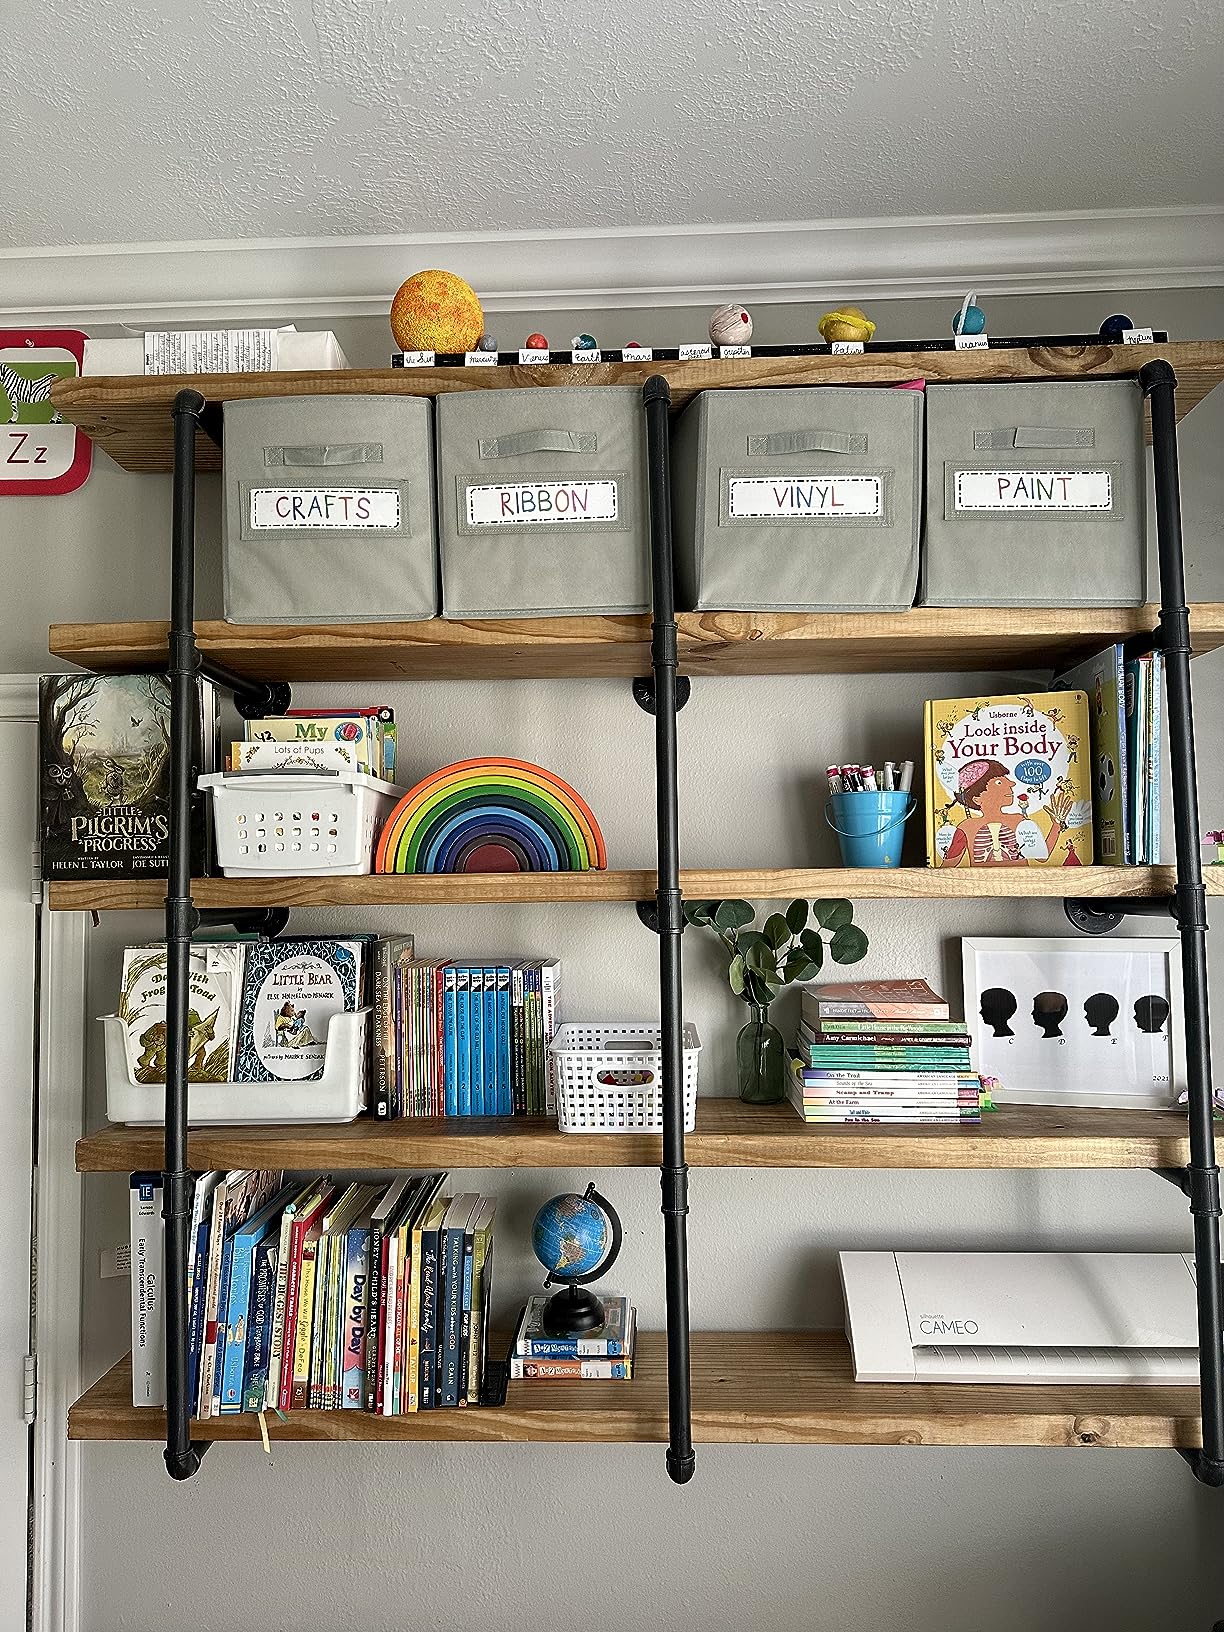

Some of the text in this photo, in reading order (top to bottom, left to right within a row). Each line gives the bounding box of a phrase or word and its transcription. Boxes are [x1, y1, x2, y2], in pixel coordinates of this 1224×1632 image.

[417, 351, 435, 364] Sun
[521, 353, 549, 362] Venus
[575, 353, 600, 363] Earth
[773, 485, 845, 508] VINYL
[997, 477, 1072, 501] PAINT
[275, 495, 372, 520] CRAFTS
[500, 489, 589, 518] RIBBON
[1118, 690, 1126, 709] BODY
[988, 711, 1018, 719] Usborne
[295, 723, 328, 741] My
[964, 720, 1047, 738] Look inside
[274, 746, 325, 756] Lots of Pups
[948, 734, 1063, 761] Your Body
[1023, 766, 1043, 776] 100
[102, 807, 136, 816] LITTLE
[71, 814, 169, 842] PILGRIM'S
[83, 837, 158, 852] PROGRESS
[52, 860, 124, 870] HELEN TAYLOR
[132, 859, 147, 870] JOE
[272, 973, 334, 986] LITTLE BEAR
[141, 984, 216, 1003] Frog Toad
[375, 1004, 382, 1013] OF
[825, 1034, 839, 1043] Amy
[379, 1055, 387, 1092] PETERSON
[141, 1187, 151, 1197] IE
[451, 1236, 459, 1264] TALKING
[137, 1238, 147, 1348] Early Transcendental Functions
[147, 1273, 155, 1311] Calculus
[257, 1268, 267, 1303] PROMISES
[366, 1228, 380, 1339] HONEY CHILD'S HEART
[420, 1250, 437, 1332] The Family
[450, 1279, 458, 1300] YOUR
[272, 1262, 288, 1359] THE BIGGEST STORY
[302, 1297, 308, 1307] We
[449, 1300, 457, 1315] KIDS
[229, 1248, 244, 1386] Bible Stories Usborne
[256, 1309, 265, 1324] GOD
[348, 1274, 367, 1354] Day by Day
[298, 1319, 309, 1342] Giggle
[919, 1320, 979, 1335] CAMEO
[297, 1347, 305, 1372] DeFeo
